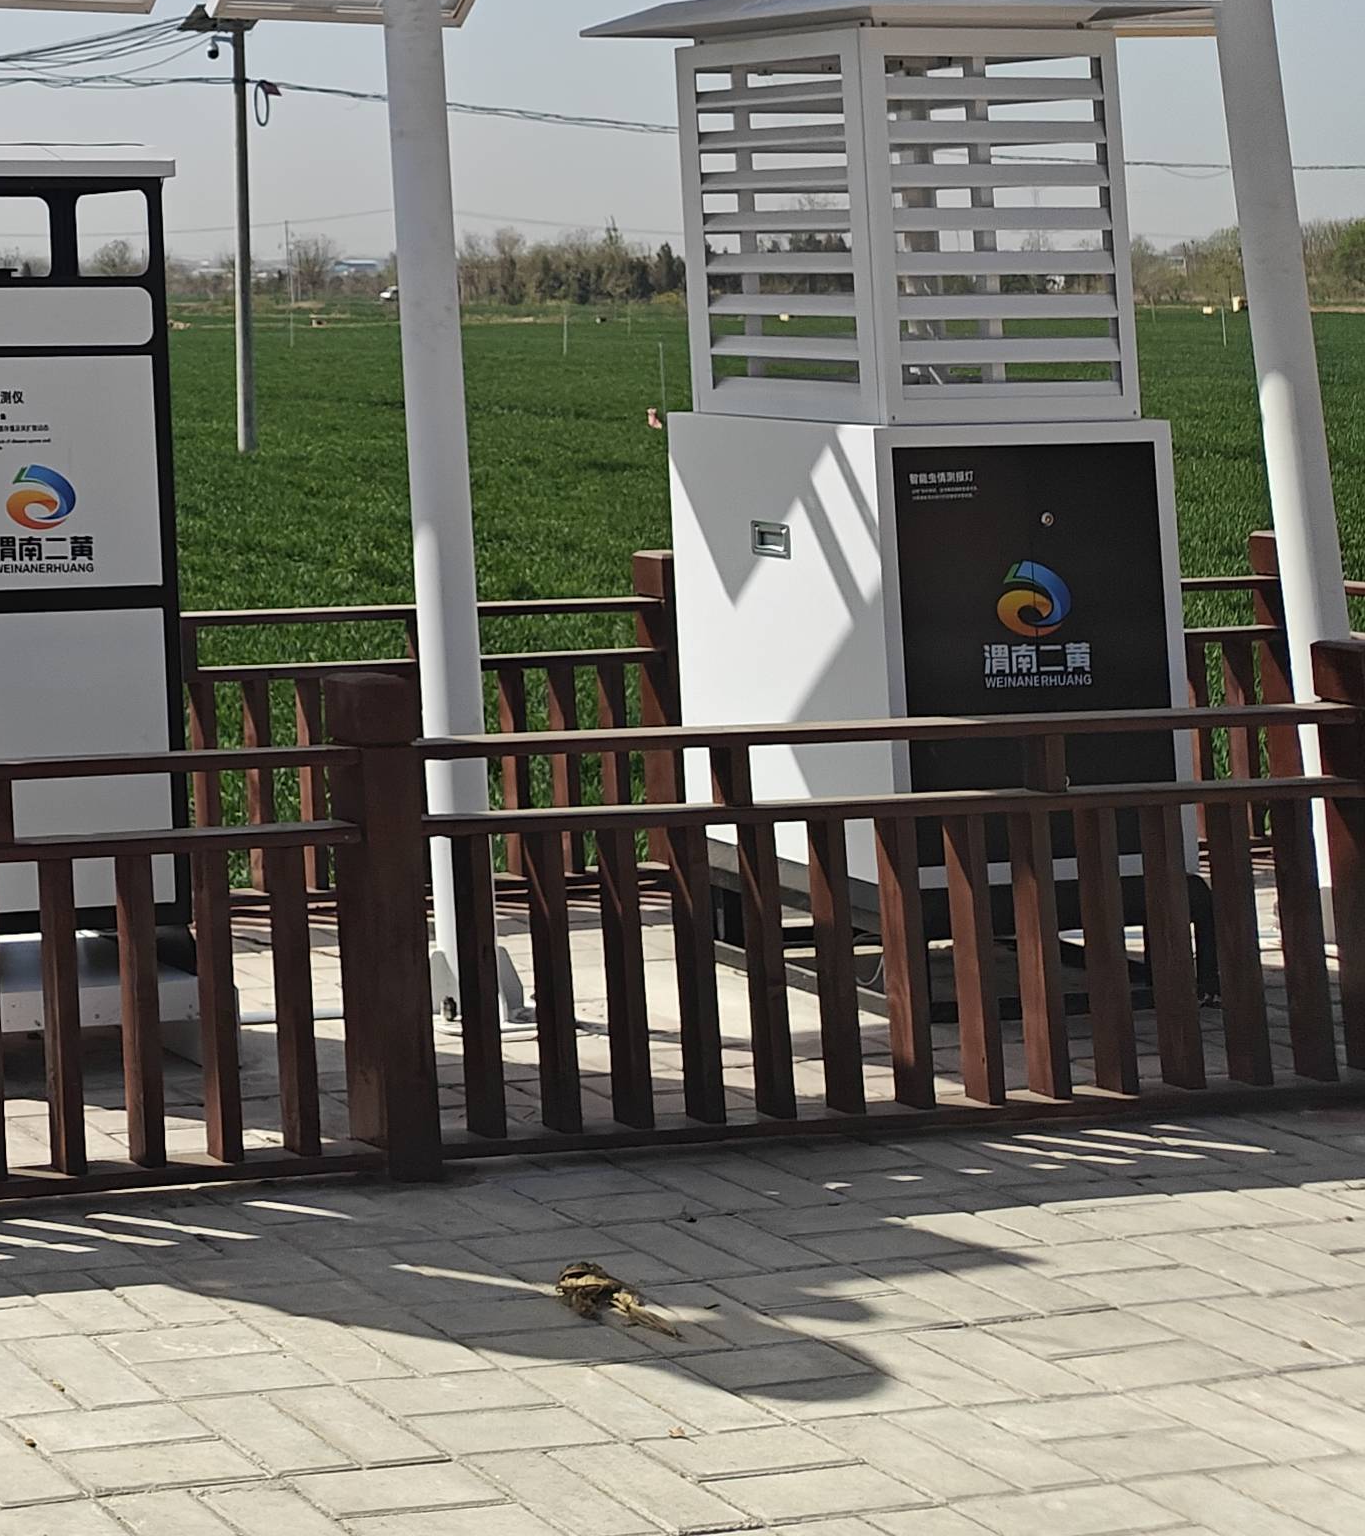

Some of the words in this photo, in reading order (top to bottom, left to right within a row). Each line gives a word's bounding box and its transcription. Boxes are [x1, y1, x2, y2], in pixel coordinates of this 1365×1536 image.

[983, 642, 1091, 674] 渭南二黄
[984, 674, 1092, 688] WEINANERHUANG
